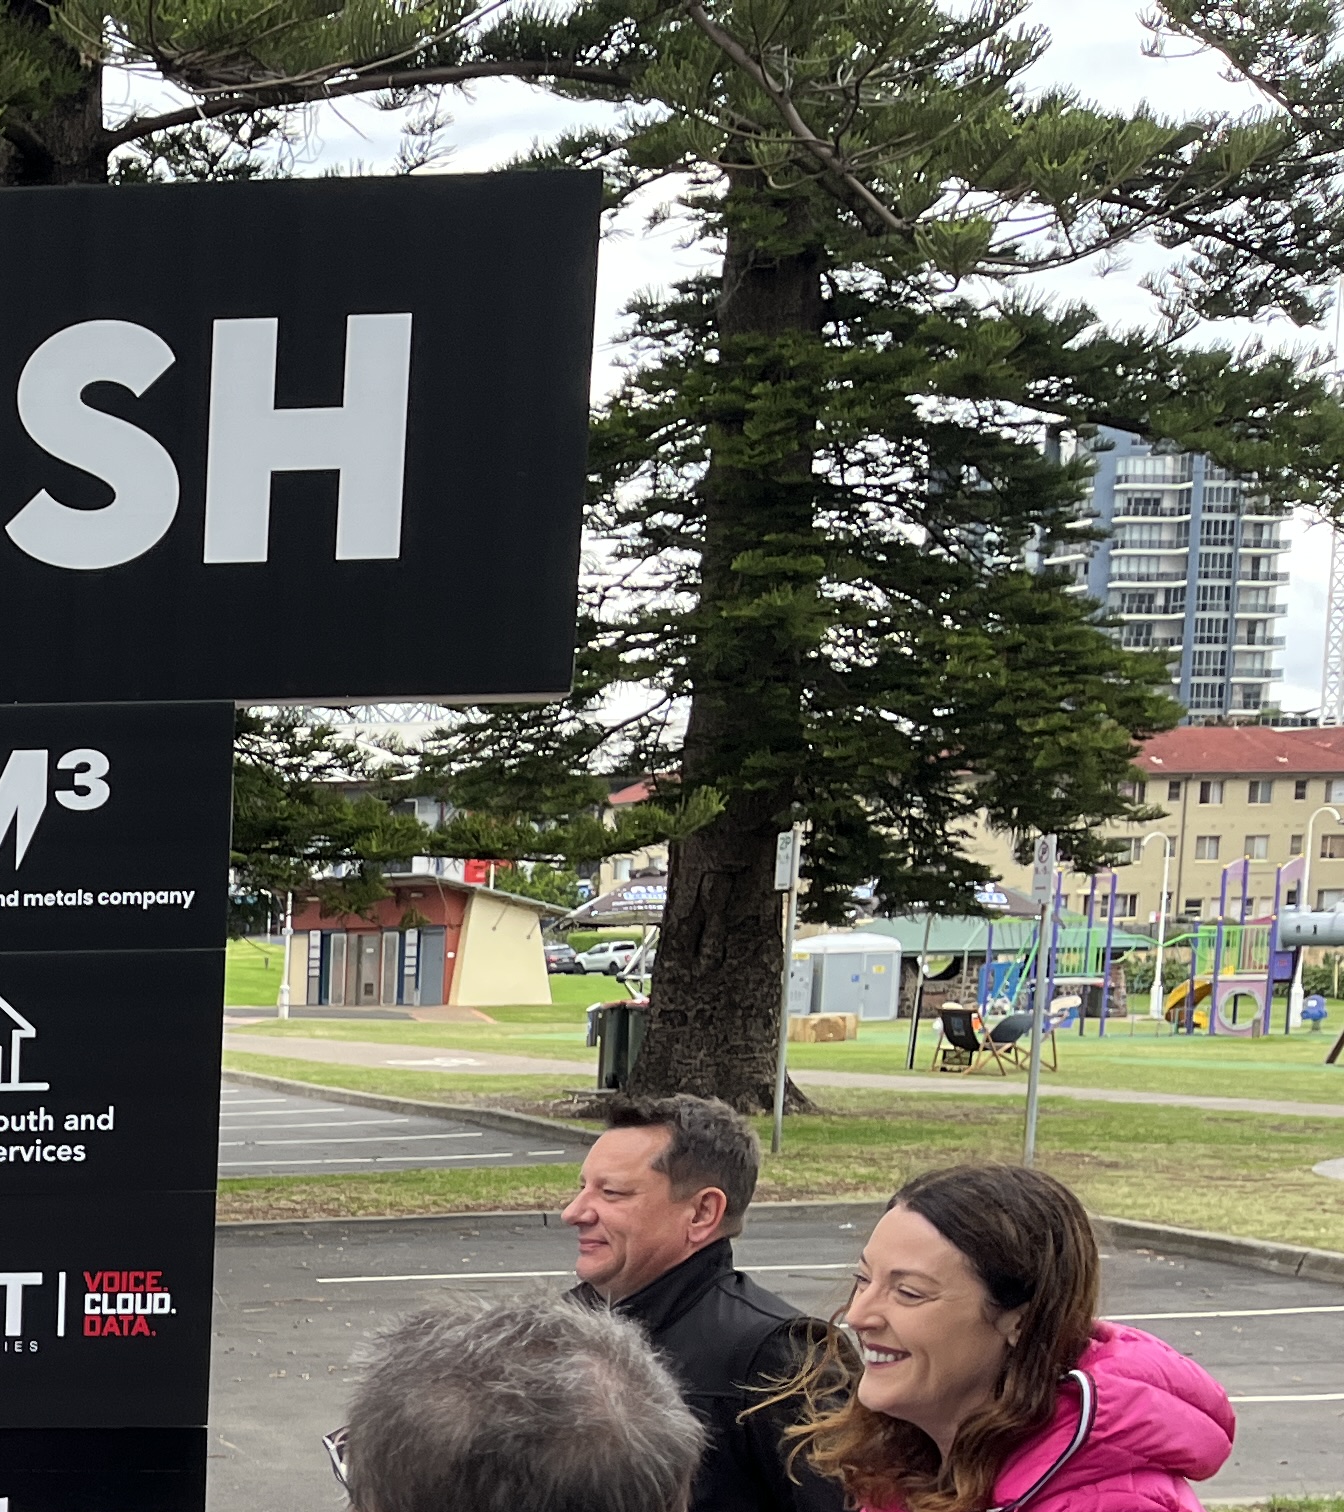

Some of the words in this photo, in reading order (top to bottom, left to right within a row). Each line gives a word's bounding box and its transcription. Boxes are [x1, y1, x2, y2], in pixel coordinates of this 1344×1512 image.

[23, 888, 93, 907] metals
[97, 888, 195, 911] company
[63, 1105, 115, 1131] and
[83, 1270, 169, 1292] VOICE.
[84, 1292, 177, 1315] CLOUD.
[83, 1315, 157, 1337] DATA.
